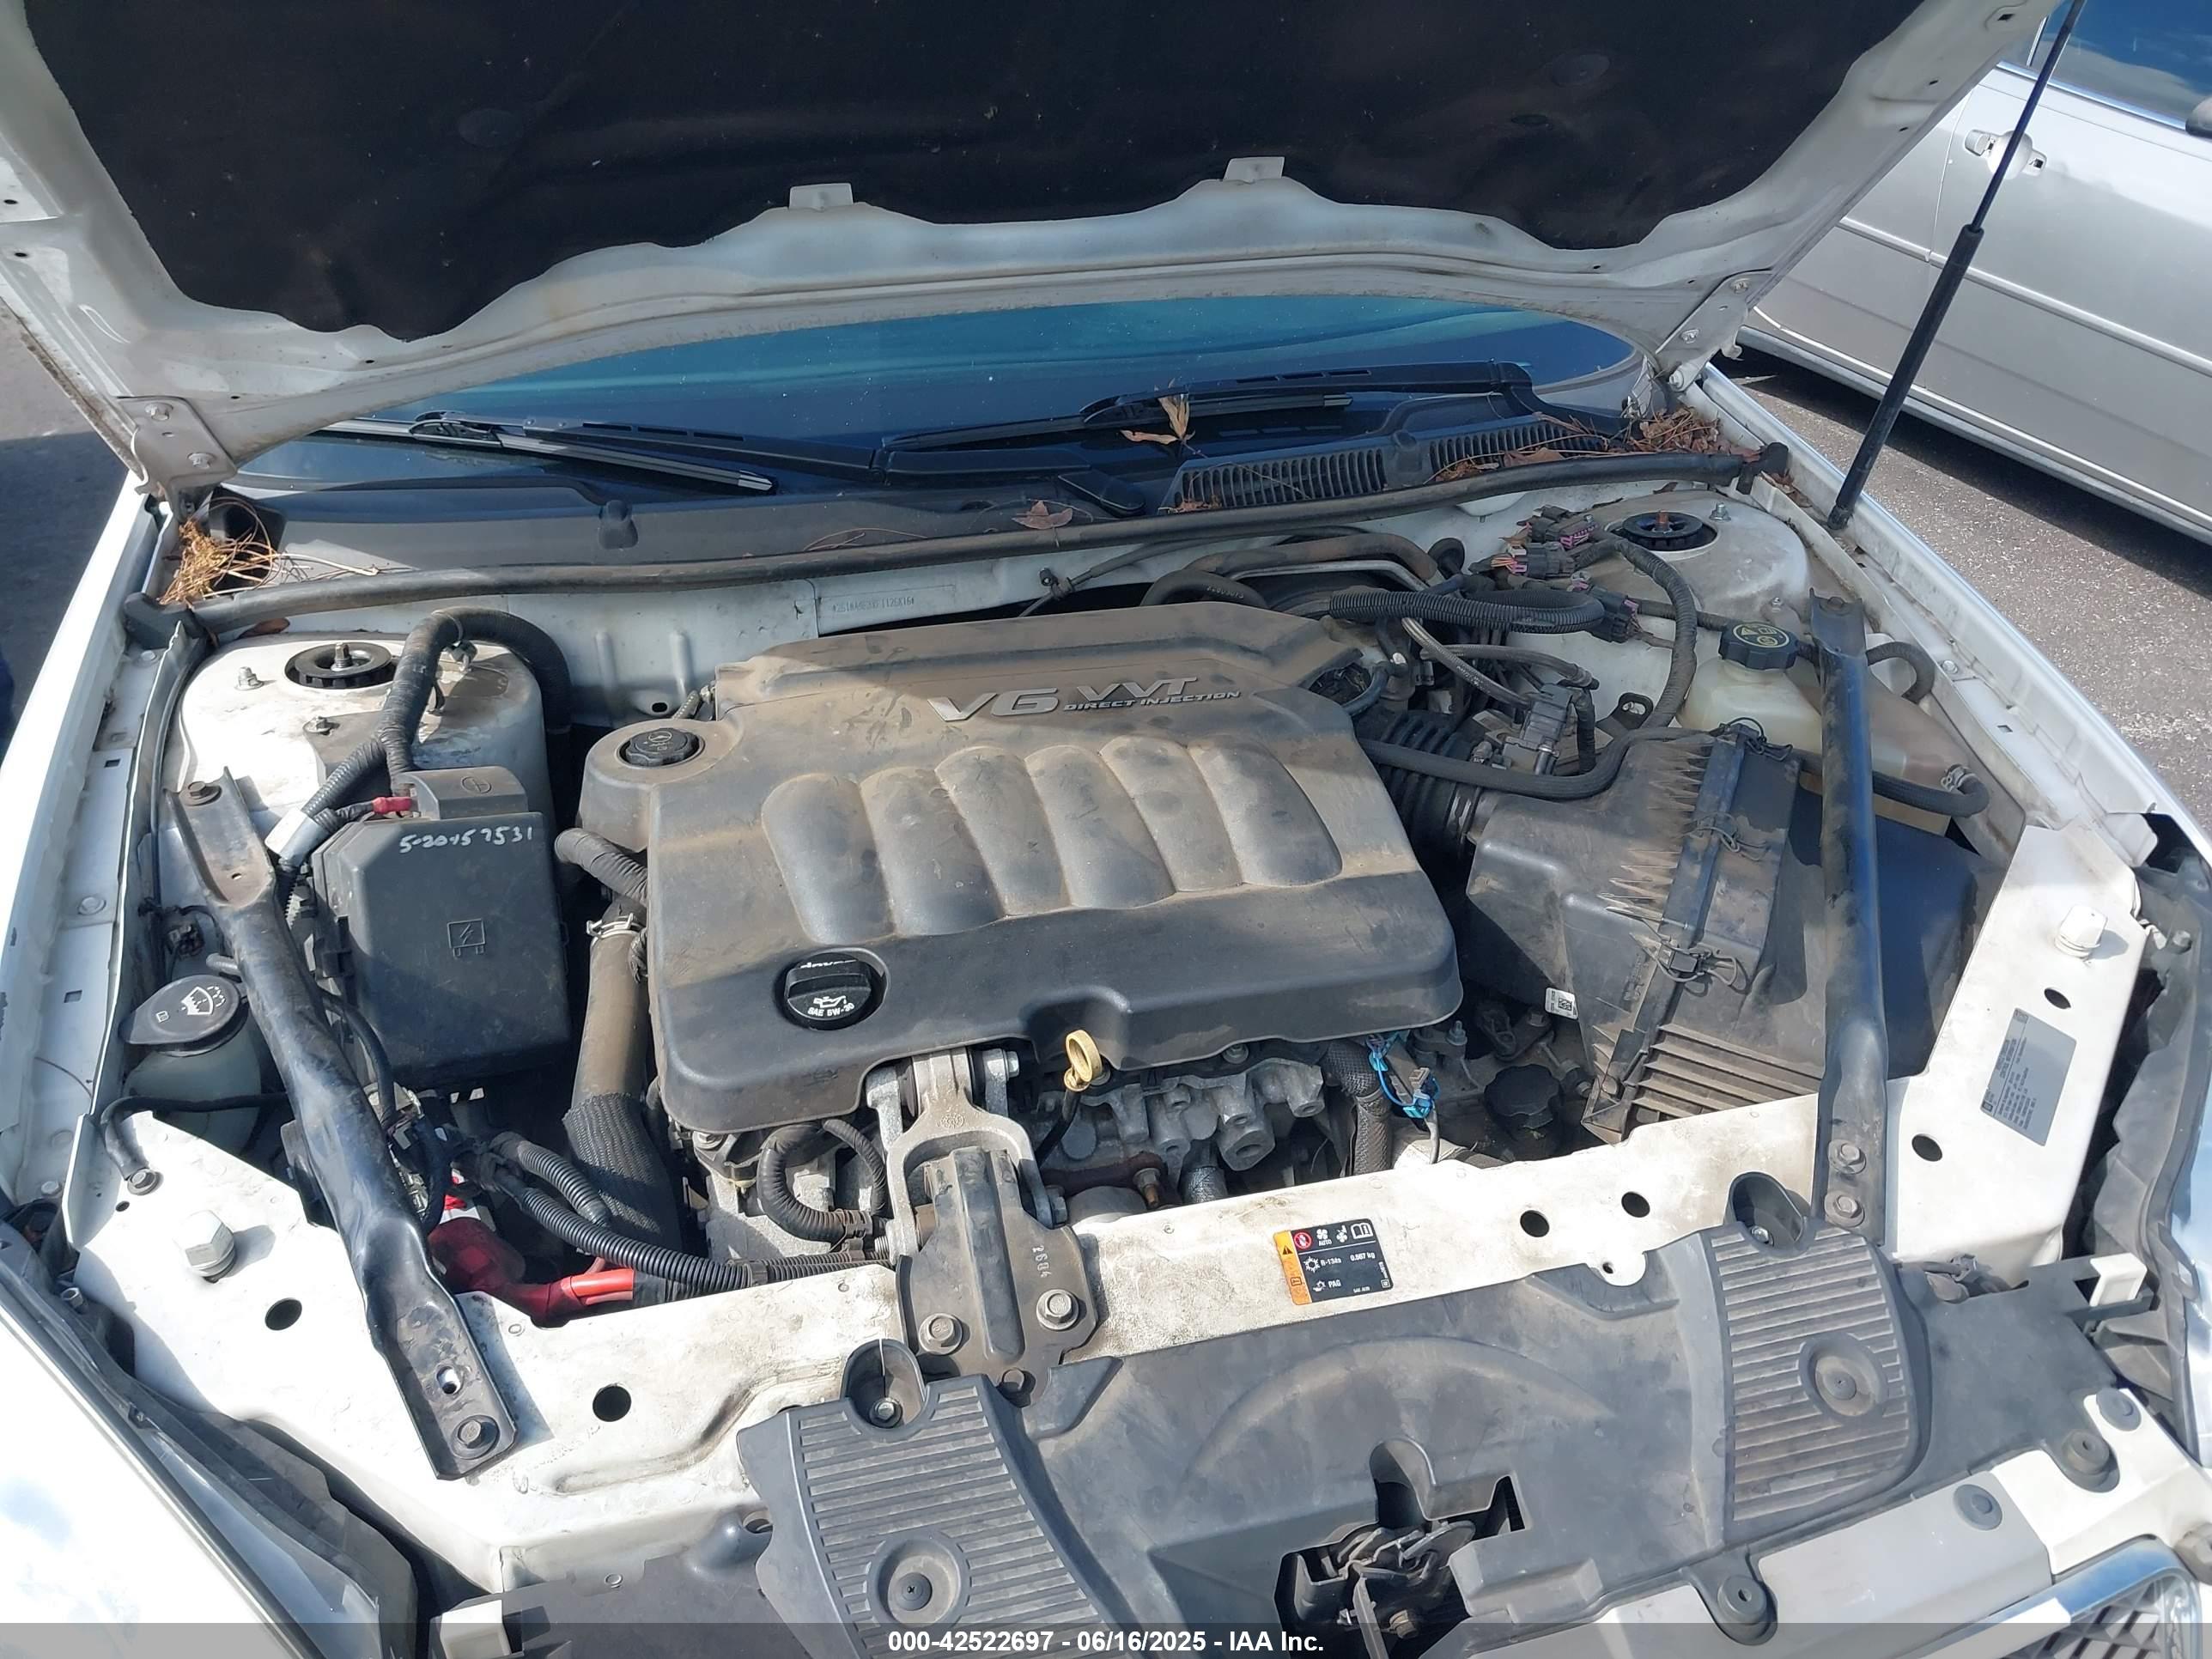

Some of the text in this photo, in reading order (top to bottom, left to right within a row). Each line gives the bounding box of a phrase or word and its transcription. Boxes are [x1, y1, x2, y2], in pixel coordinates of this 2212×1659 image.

[927, 676, 1199, 721] V6 VVT
[1063, 690, 1241, 711] DIRECT INJECTION
[807, 1002, 855, 1016] SAE 5W-30
[1328, 1279, 1341, 1288] PAG
